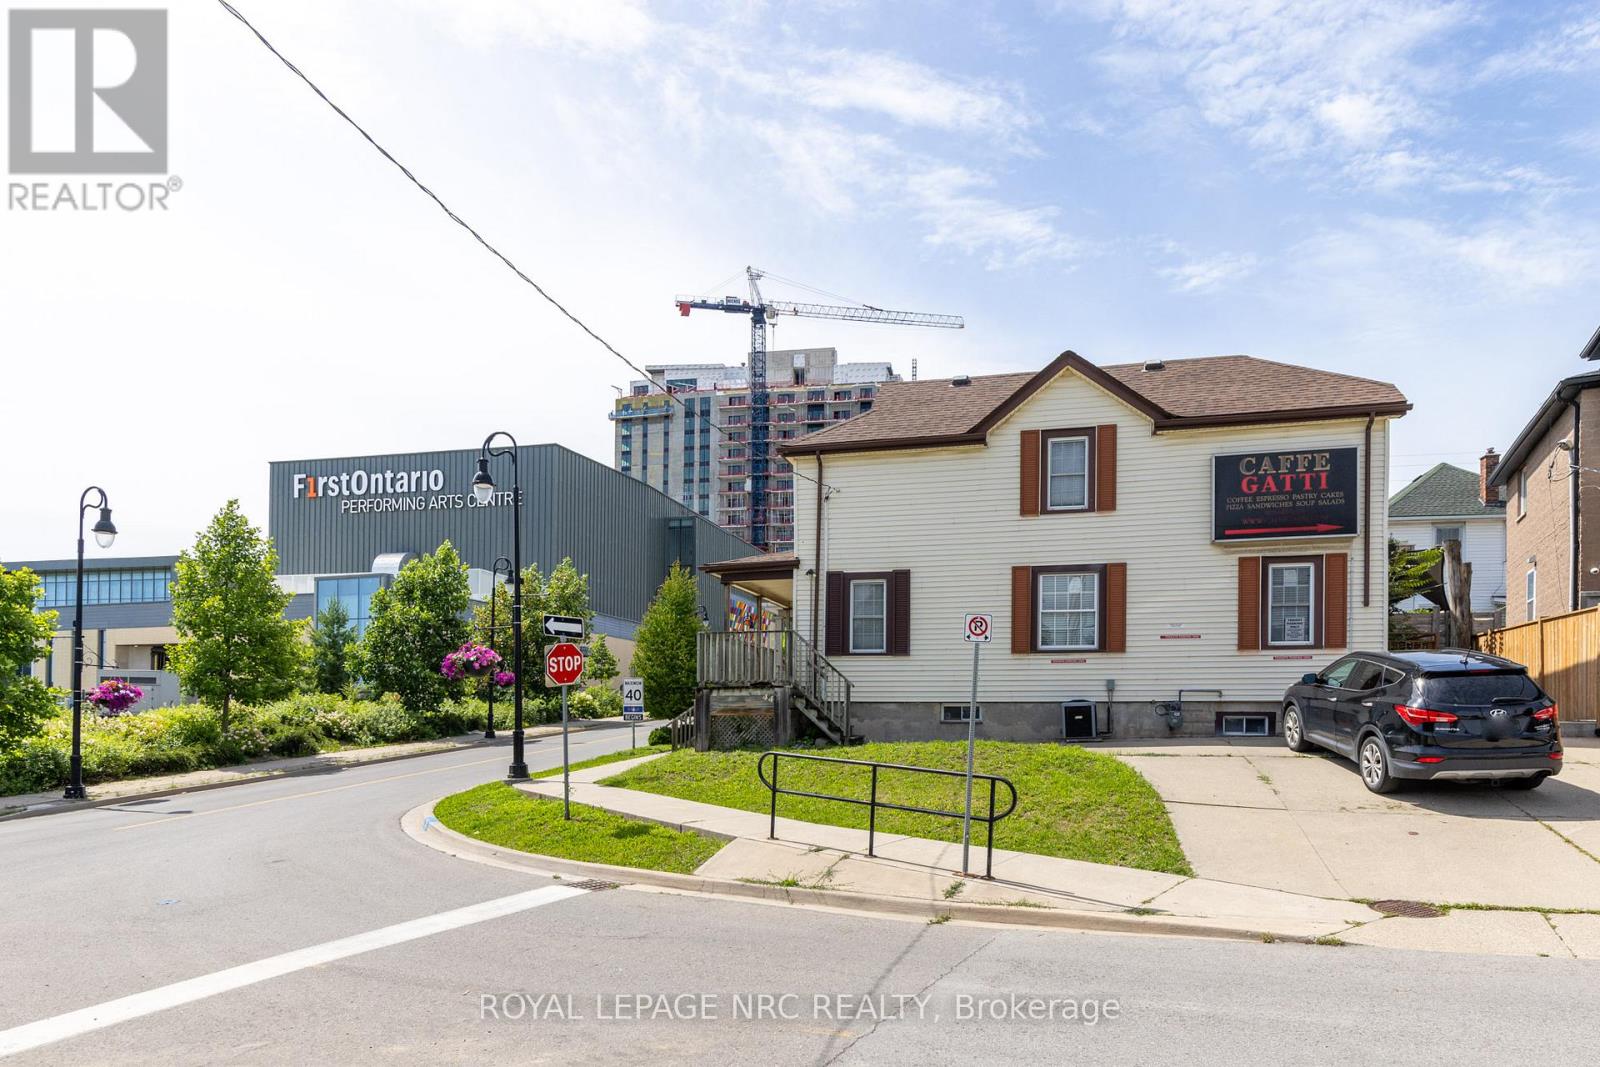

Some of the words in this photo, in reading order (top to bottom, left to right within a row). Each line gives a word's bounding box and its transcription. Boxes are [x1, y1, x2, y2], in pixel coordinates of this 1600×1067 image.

[1239, 452, 1331, 475] CAFFE
[1241, 471, 1329, 494] GATTI
[341, 496, 426, 514] PERFORMING
[428, 494, 463, 510] ARTS
[467, 491, 523, 508] CNTRE
[1226, 495, 1253, 504] COFFEE
[1256, 494, 1289, 502] ESPRESSO
[1292, 492, 1317, 500] PASTRY
[1320, 491, 1344, 499] CAKES
[1226, 503, 1244, 511] PIZZA
[1247, 501, 1293, 510] SANDWICHES
[1295, 499, 1316, 507] SOUP
[1318, 498, 1345, 506] SALADS
[549, 655, 581, 673] STOP
[625, 689, 642, 701] 40
